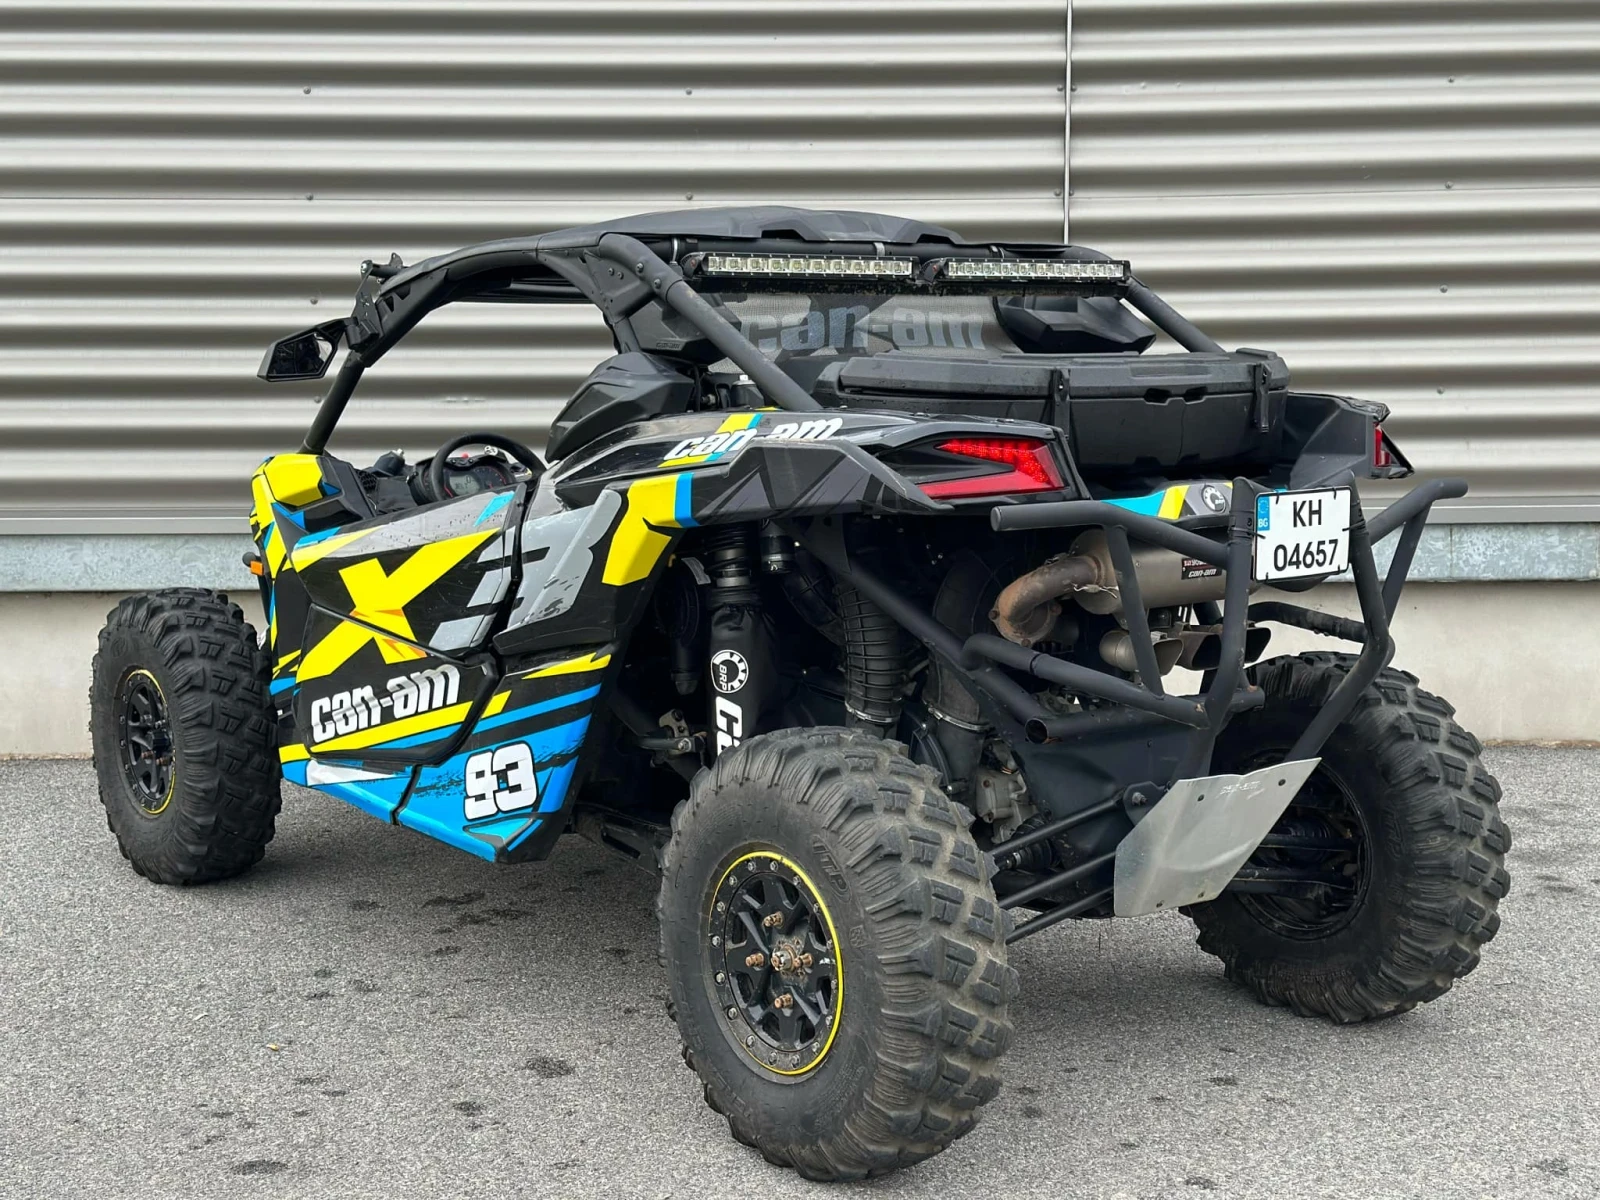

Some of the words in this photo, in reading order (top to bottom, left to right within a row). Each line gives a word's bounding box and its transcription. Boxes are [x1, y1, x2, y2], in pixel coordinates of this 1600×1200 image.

[741, 305, 987, 354] can-am
[663, 417, 844, 461] can-am
[1258, 518, 1269, 528] BG
[1293, 499, 1322, 528] KH
[1273, 539, 1338, 572] 04657
[1188, 568, 1217, 578] can-am
[718, 664, 728, 691] BRP
[311, 664, 461, 743] can-am
[464, 741, 538, 820] 93
